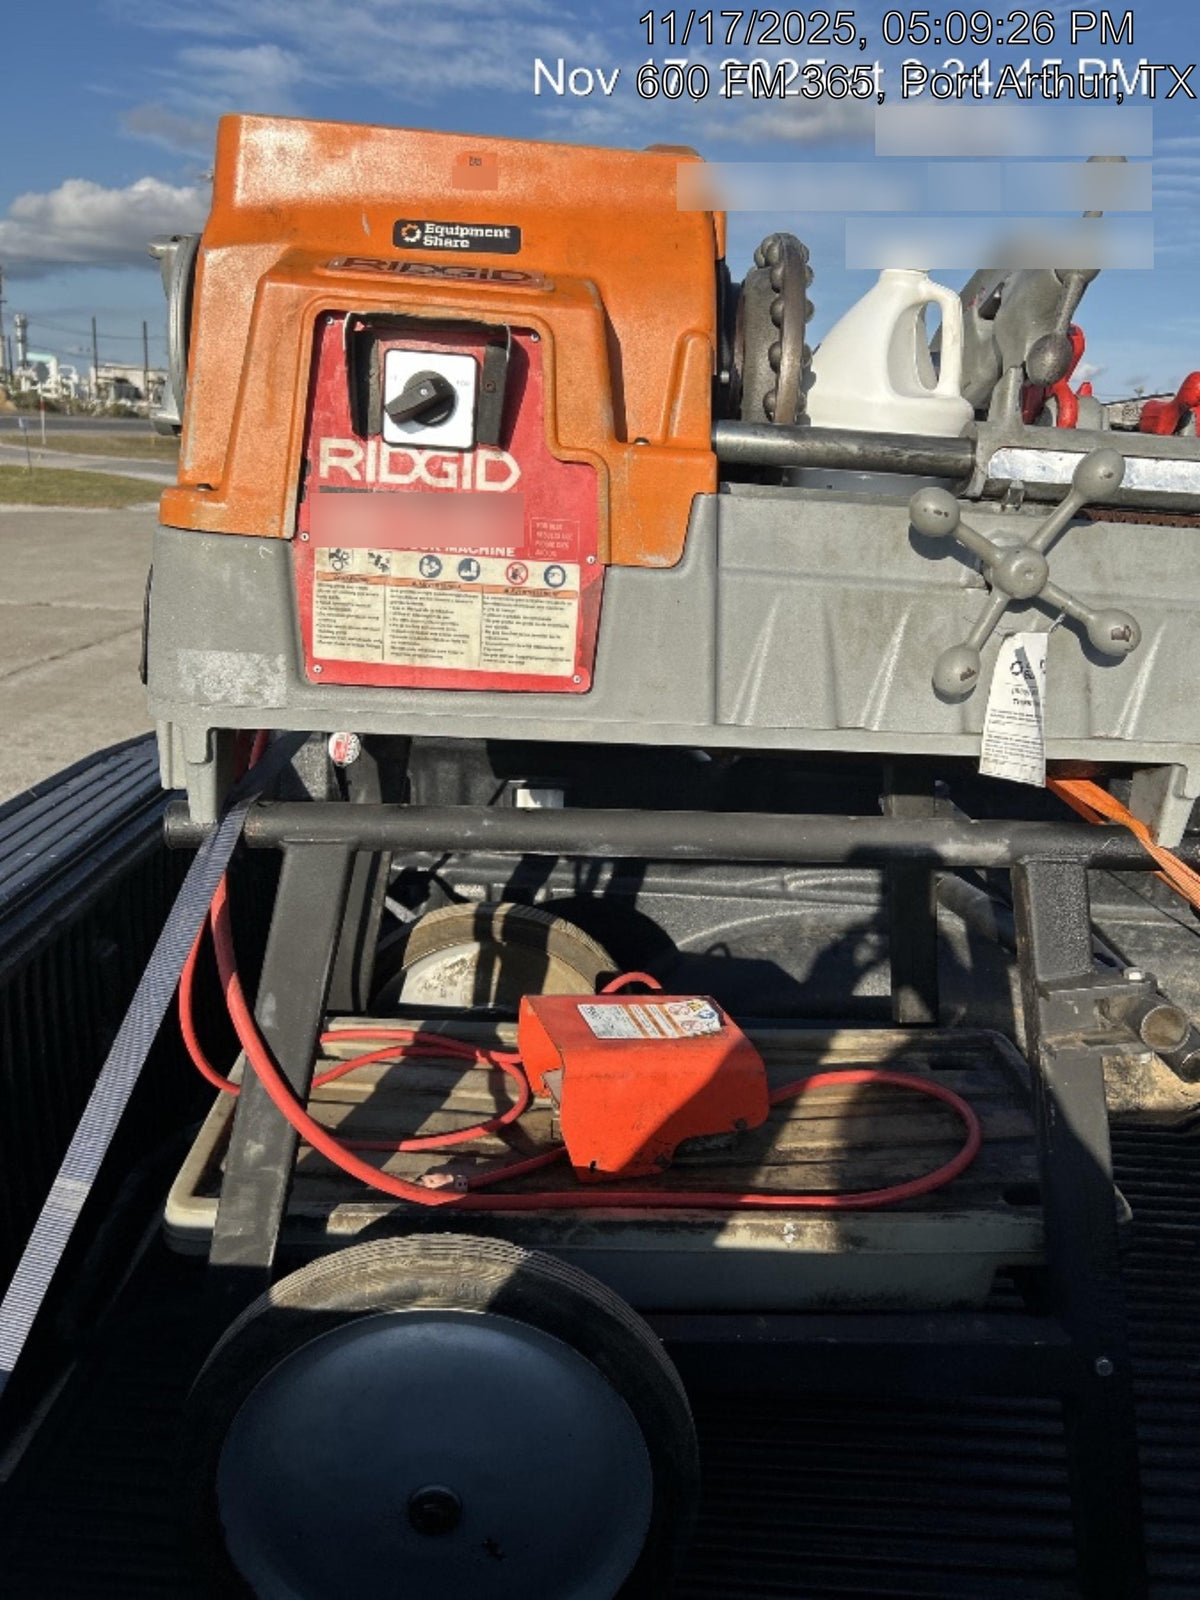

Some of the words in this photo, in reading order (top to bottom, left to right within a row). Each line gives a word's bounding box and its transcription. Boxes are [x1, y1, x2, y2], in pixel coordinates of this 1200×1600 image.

[424, 222, 512, 239] Equipment
[423, 235, 470, 249] Share
[341, 256, 533, 281] RIDGID
[318, 437, 522, 493] RIDGID
